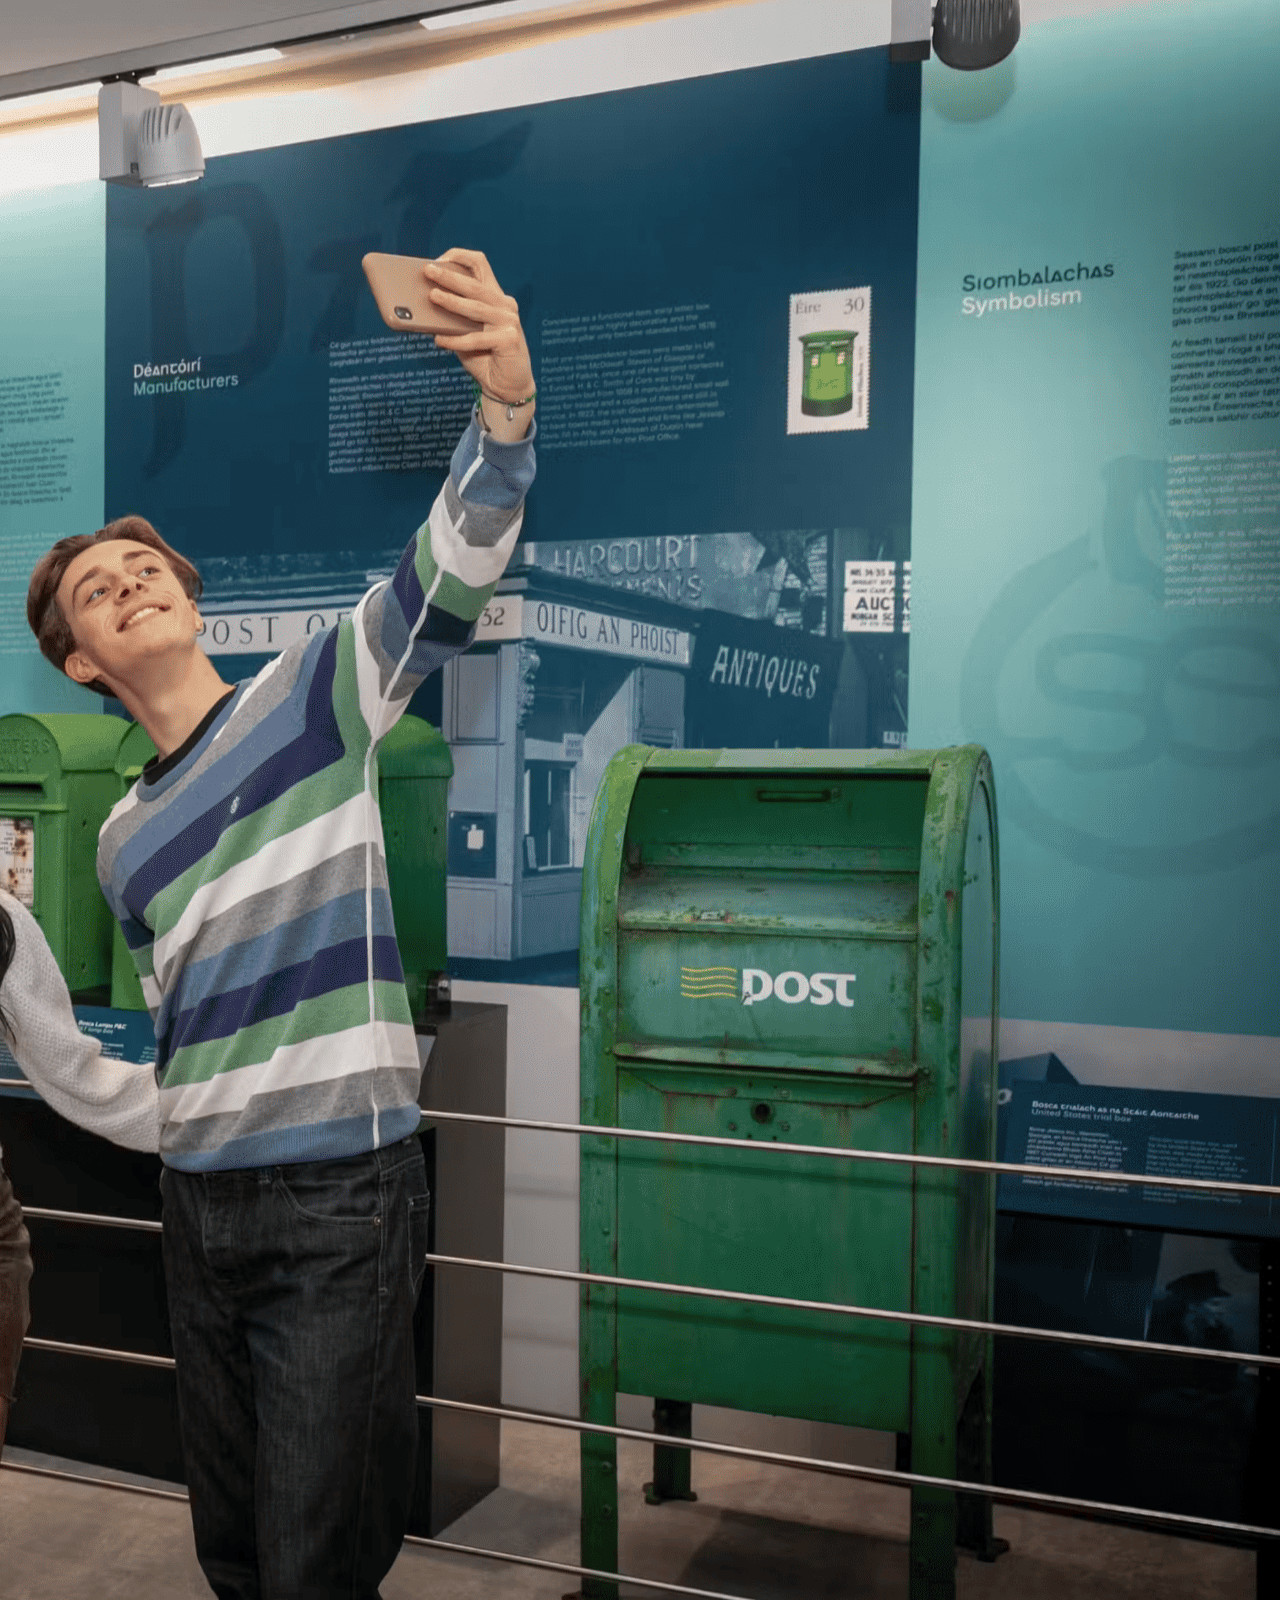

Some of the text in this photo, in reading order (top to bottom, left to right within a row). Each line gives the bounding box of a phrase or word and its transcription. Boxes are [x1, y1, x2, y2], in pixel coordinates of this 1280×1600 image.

[963, 262, 1115, 292] Siombalachas
[843, 297, 865, 315] 30
[962, 287, 1082, 318] Symbolism
[134, 356, 201, 378] Déantóirí
[133, 373, 239, 396] Manufacturers
[554, 534, 701, 577] HARCOURT
[537, 602, 680, 656] OIFIG AN PHOIST
[709, 645, 820, 701] ANTIQUES
[1031, 1108, 1061, 1118] United
[1063, 1110, 1092, 1120] States
[1032, 1100, 1059, 1110] Bosca
